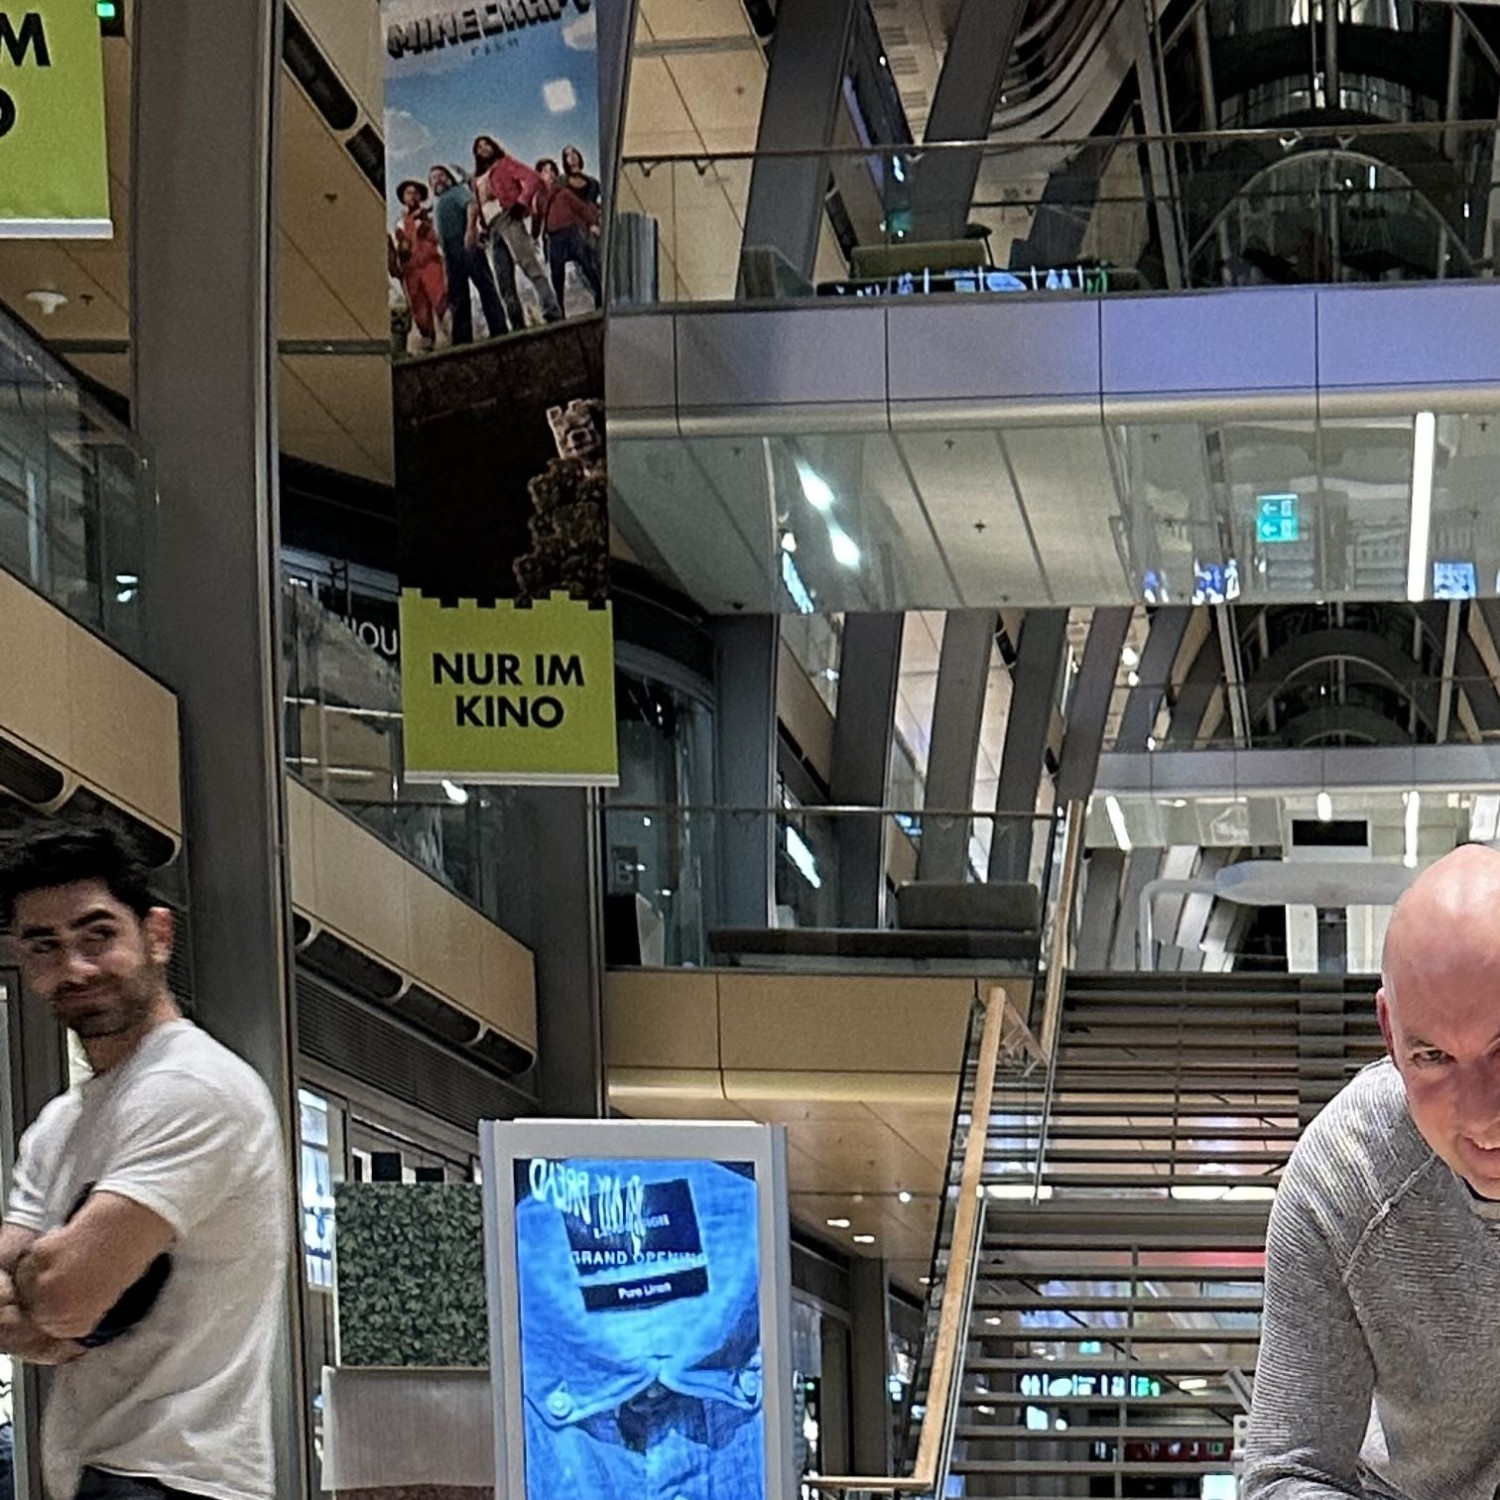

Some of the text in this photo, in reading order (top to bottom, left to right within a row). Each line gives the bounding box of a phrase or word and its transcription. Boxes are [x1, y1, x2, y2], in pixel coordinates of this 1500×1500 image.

[433, 653, 585, 686] NUR IM
[456, 696, 564, 728] KINO
[572, 1250, 628, 1265] GRAND
